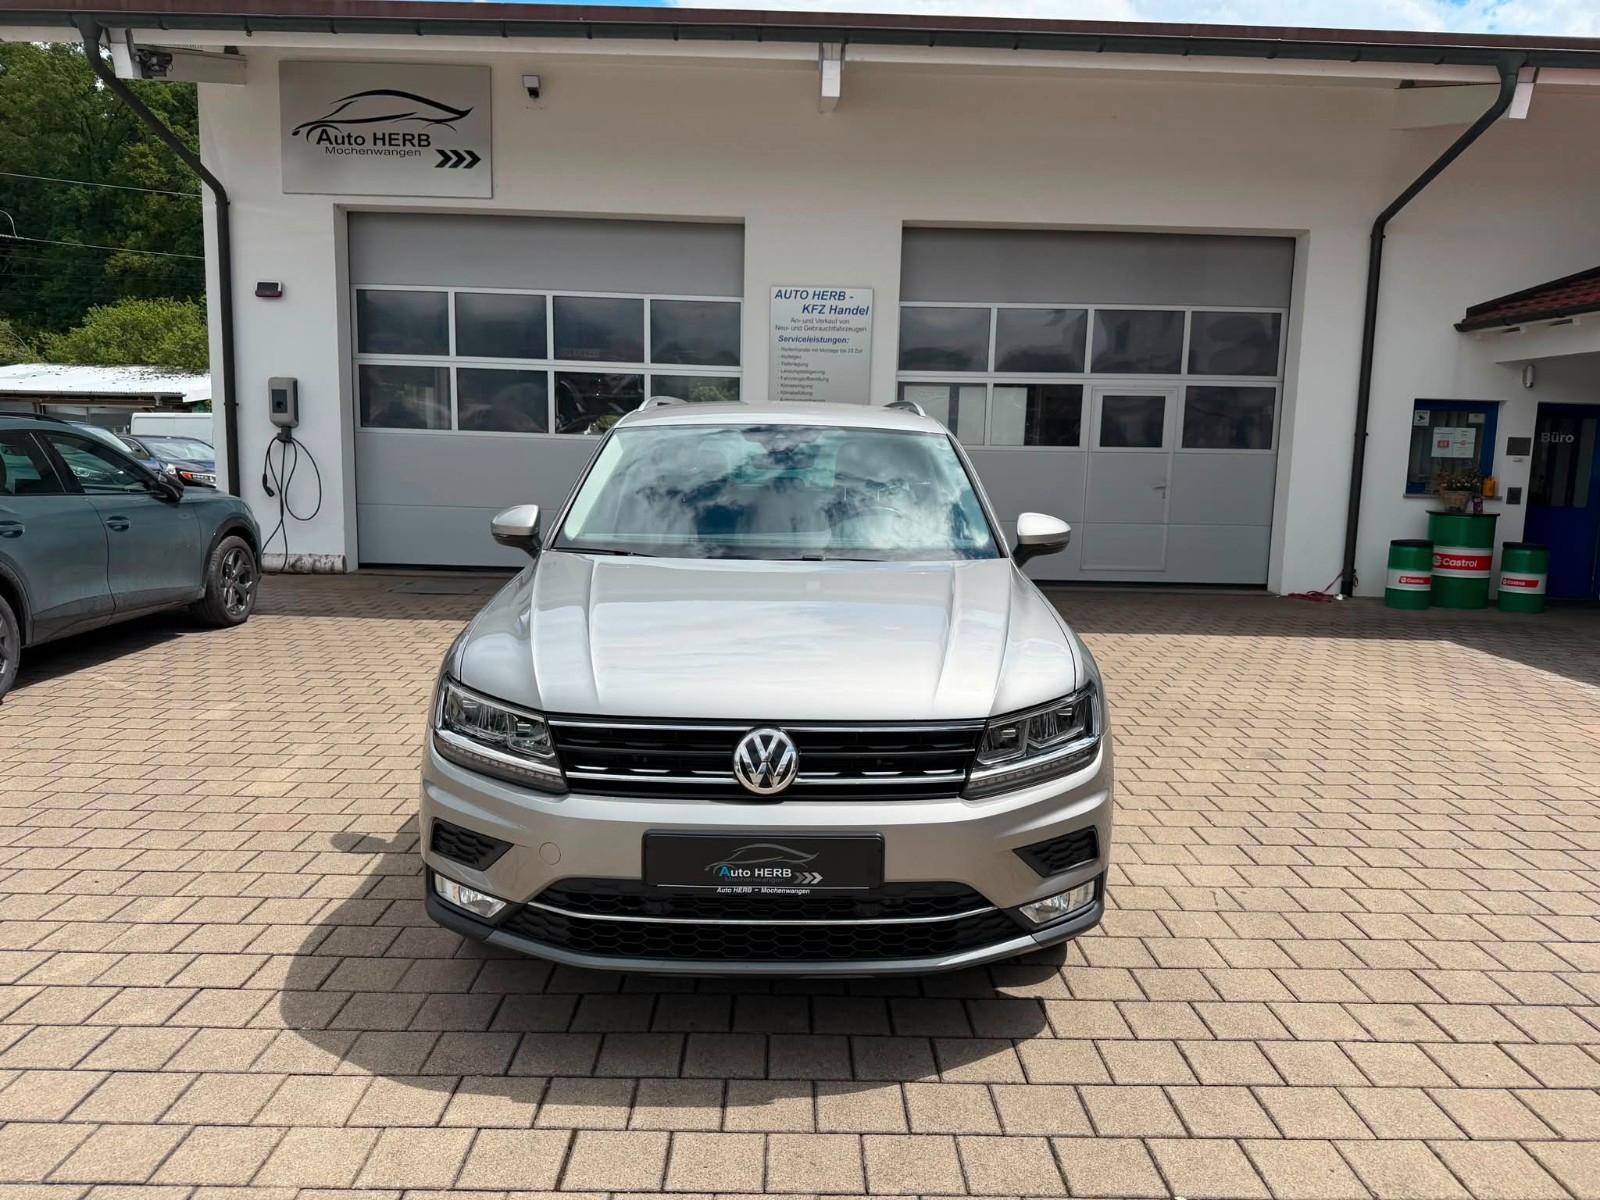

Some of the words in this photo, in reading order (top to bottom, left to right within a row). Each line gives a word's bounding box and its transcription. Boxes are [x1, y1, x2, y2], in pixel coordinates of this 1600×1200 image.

[316, 128, 366, 146] Auto
[373, 132, 431, 148] HERB
[325, 146, 422, 158] Mochenwangen
[775, 289, 809, 300] AUTO
[812, 290, 847, 301] HERB
[801, 303, 826, 315] KFZ
[829, 304, 870, 316] Handel
[815, 317, 839, 325] Verkauf
[791, 324, 802, 332] und
[778, 335, 850, 345] Serviceleistungen:
[1540, 431, 1575, 444] Büro
[1442, 557, 1478, 569] Castrol
[719, 865, 751, 878] Auto
[754, 868, 792, 878] HERB
[716, 886, 732, 894] Auto
[733, 886, 753, 894] HERB
[761, 886, 811, 896] Mochenwangen
